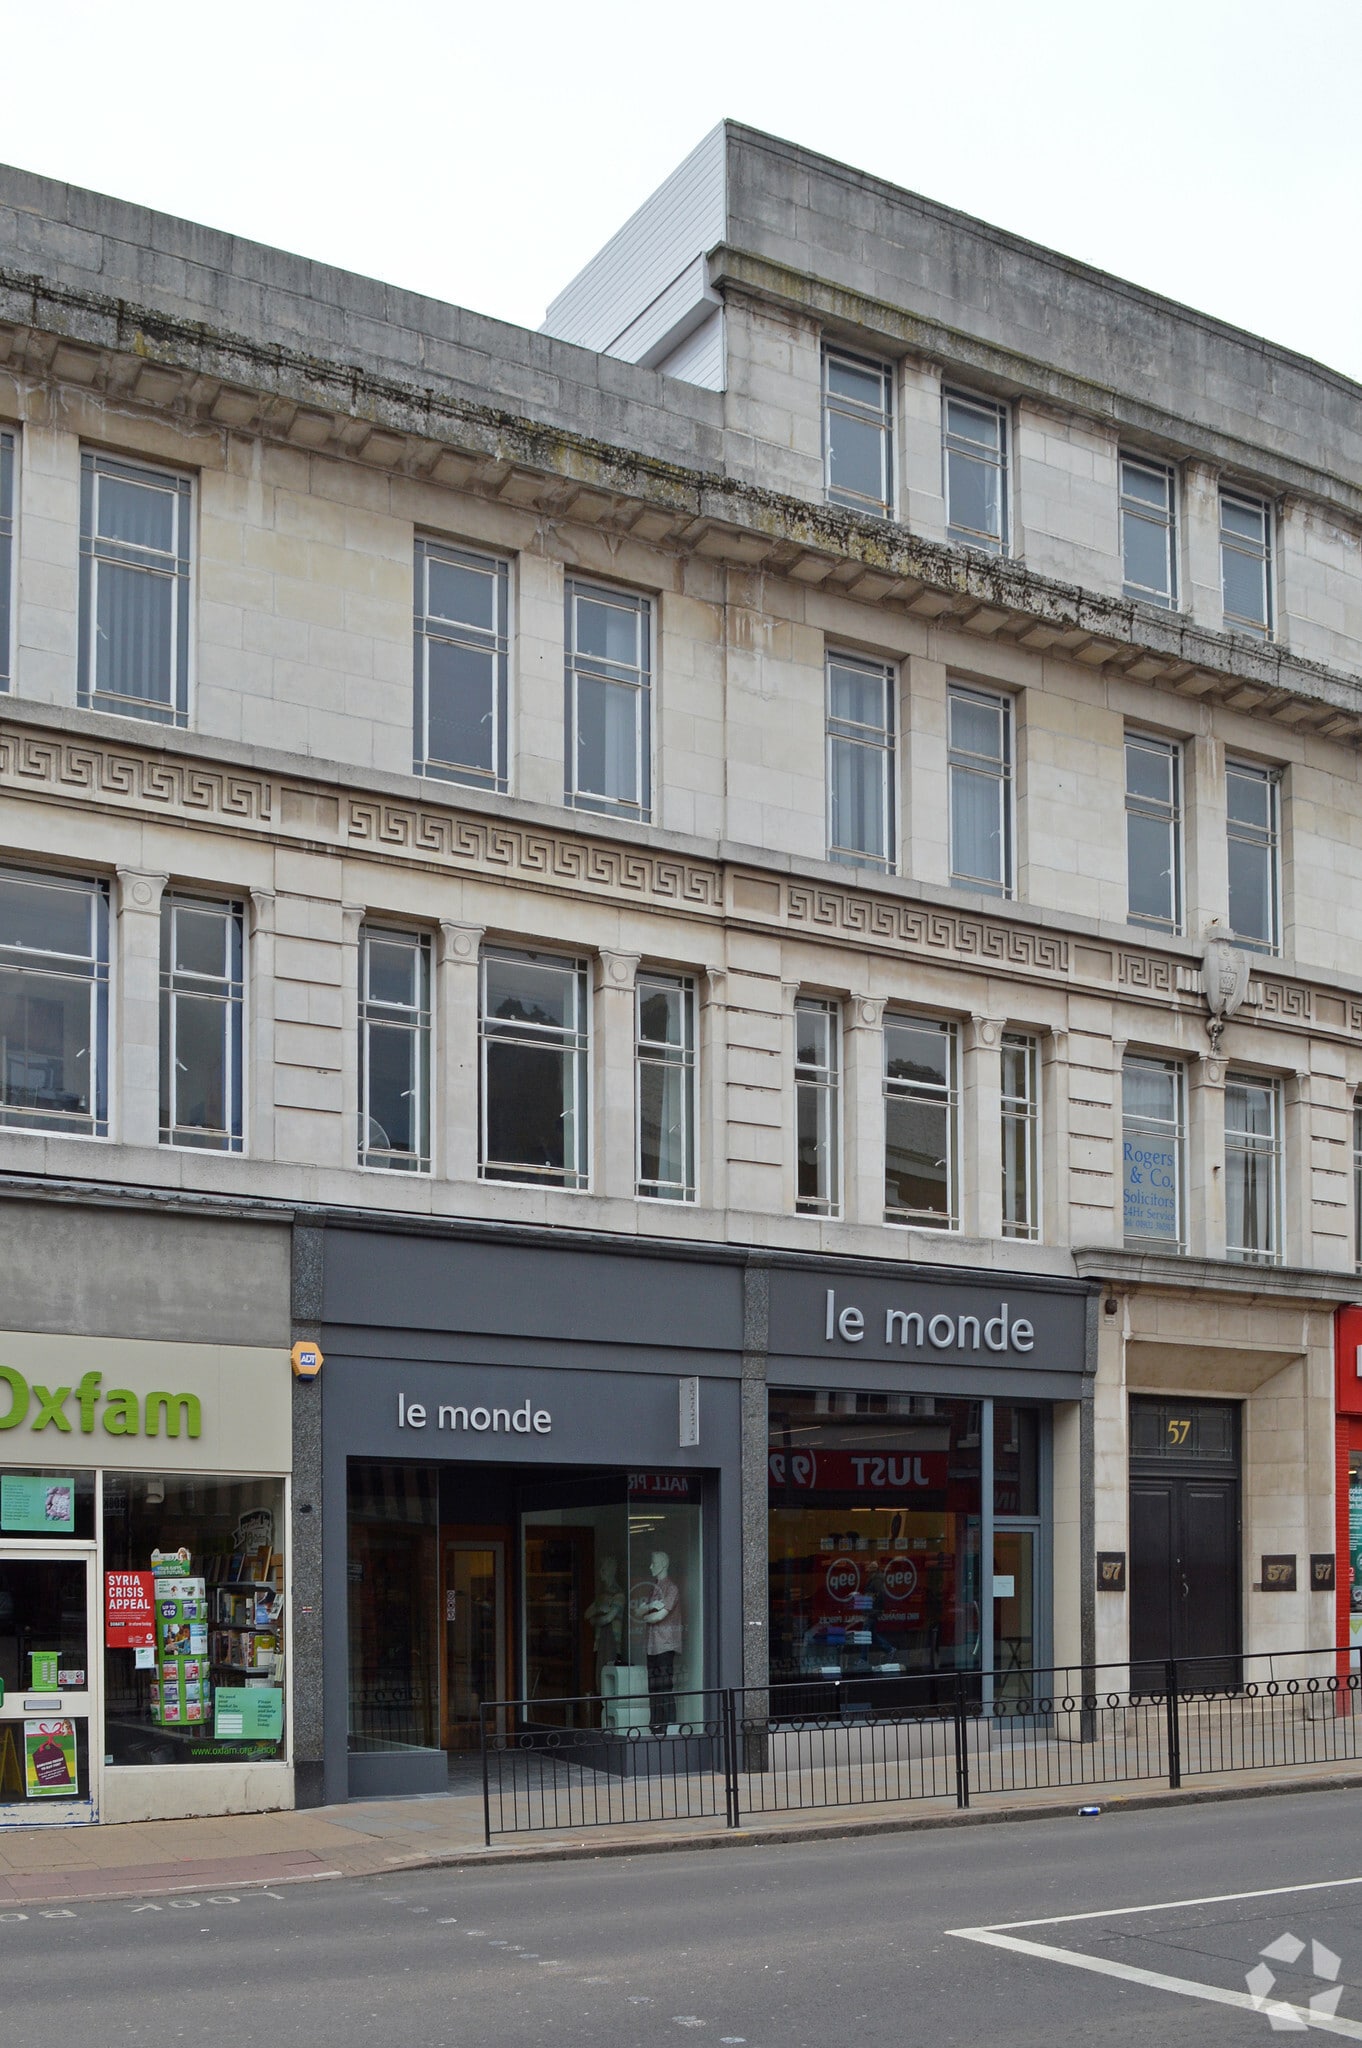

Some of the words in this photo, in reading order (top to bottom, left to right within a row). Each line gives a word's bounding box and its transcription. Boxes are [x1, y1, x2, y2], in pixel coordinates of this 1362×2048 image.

[1123, 1143, 1173, 1169] Rogers
[1130, 1166, 1142, 1184] &
[1123, 1188, 1175, 1208] Solicitors
[1123, 1205, 1143, 1217] 24Hr
[1147, 1208, 1176, 1220] Service
[826, 1289, 865, 1342] le
[885, 1303, 1035, 1351] monde
[301, 1352, 316, 1364] ADT
[0, 1365, 202, 1437] Oxfam
[397, 1392, 427, 1429] le
[438, 1399, 552, 1434] monde
[1167, 1420, 1191, 1445] 57
[1102, 1561, 1121, 1580] 57
[1267, 1564, 1291, 1582] 57
[1315, 1563, 1332, 1580] 57
[108, 1575, 141, 1586] SYRIA
[108, 1587, 144, 1597] CRISIS
[109, 1599, 151, 1610] APPEAL
[191, 1746, 277, 1756] www.oxfam.org/shop
[123, 1891, 285, 1914] LOOK
